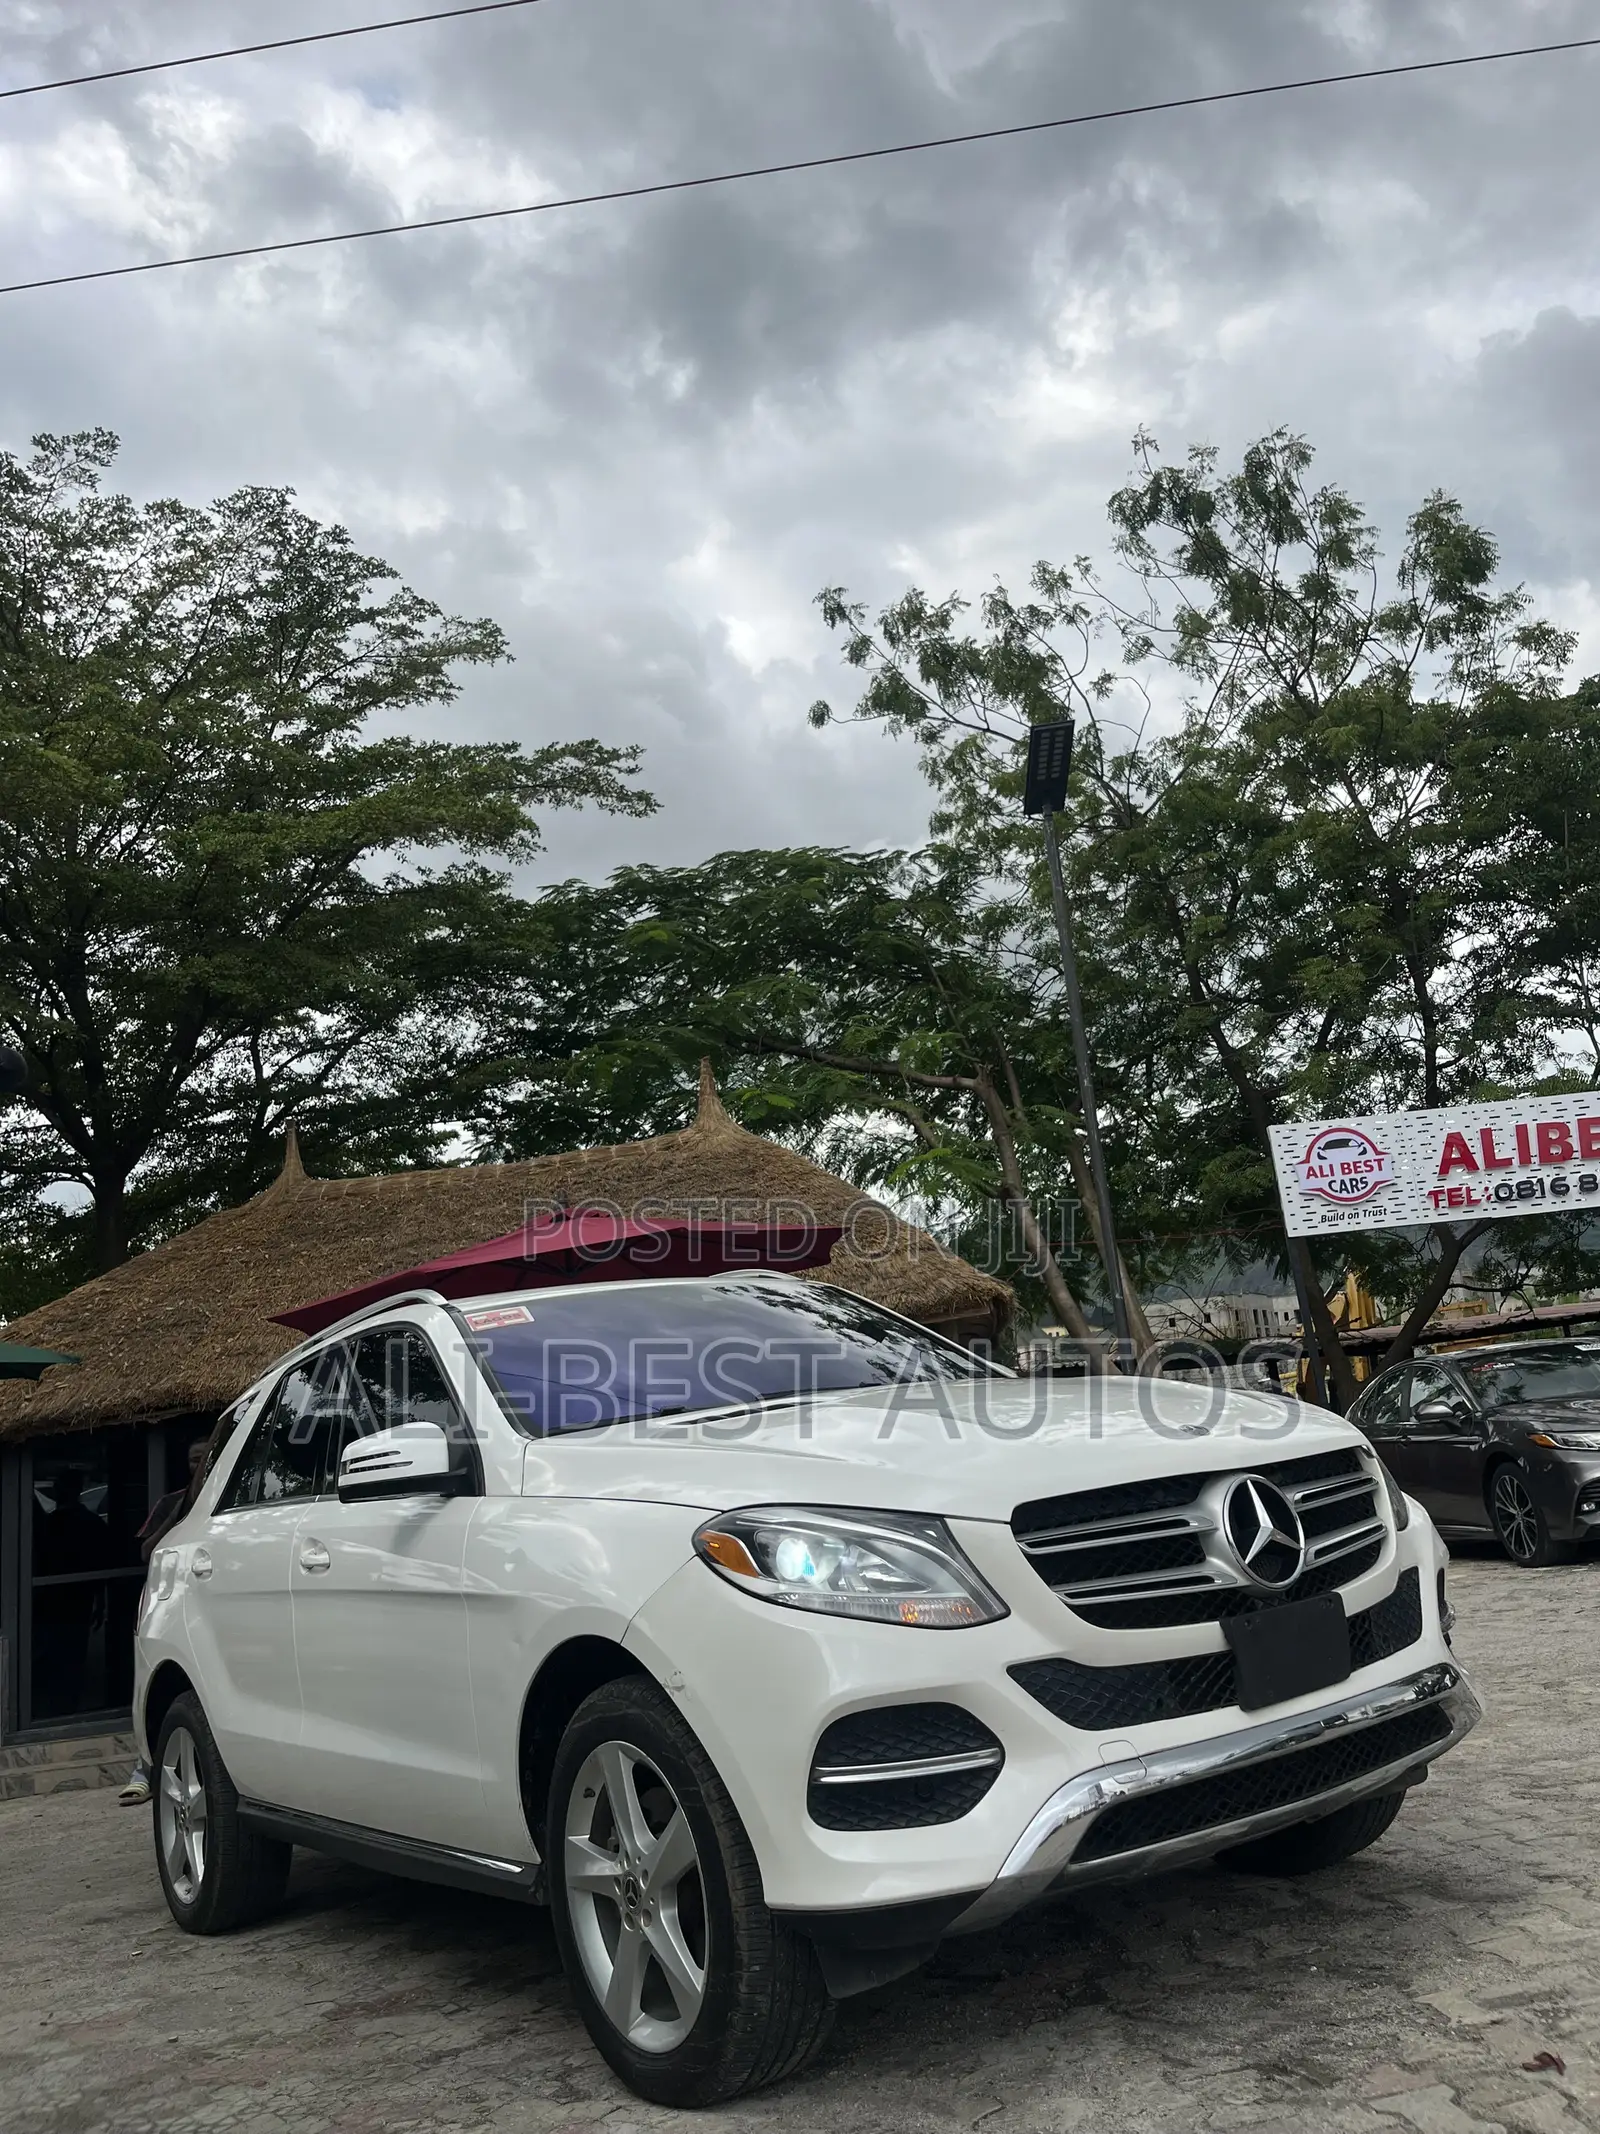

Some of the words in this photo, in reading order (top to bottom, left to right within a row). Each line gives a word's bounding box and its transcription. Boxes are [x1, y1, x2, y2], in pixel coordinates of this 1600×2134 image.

[1306, 1163, 1335, 1179] ALI
[1340, 1158, 1385, 1176] BEST
[1327, 1176, 1369, 1194] CARS
[1347, 1211, 1360, 1219] on
[1362, 1207, 1387, 1218] Trust
